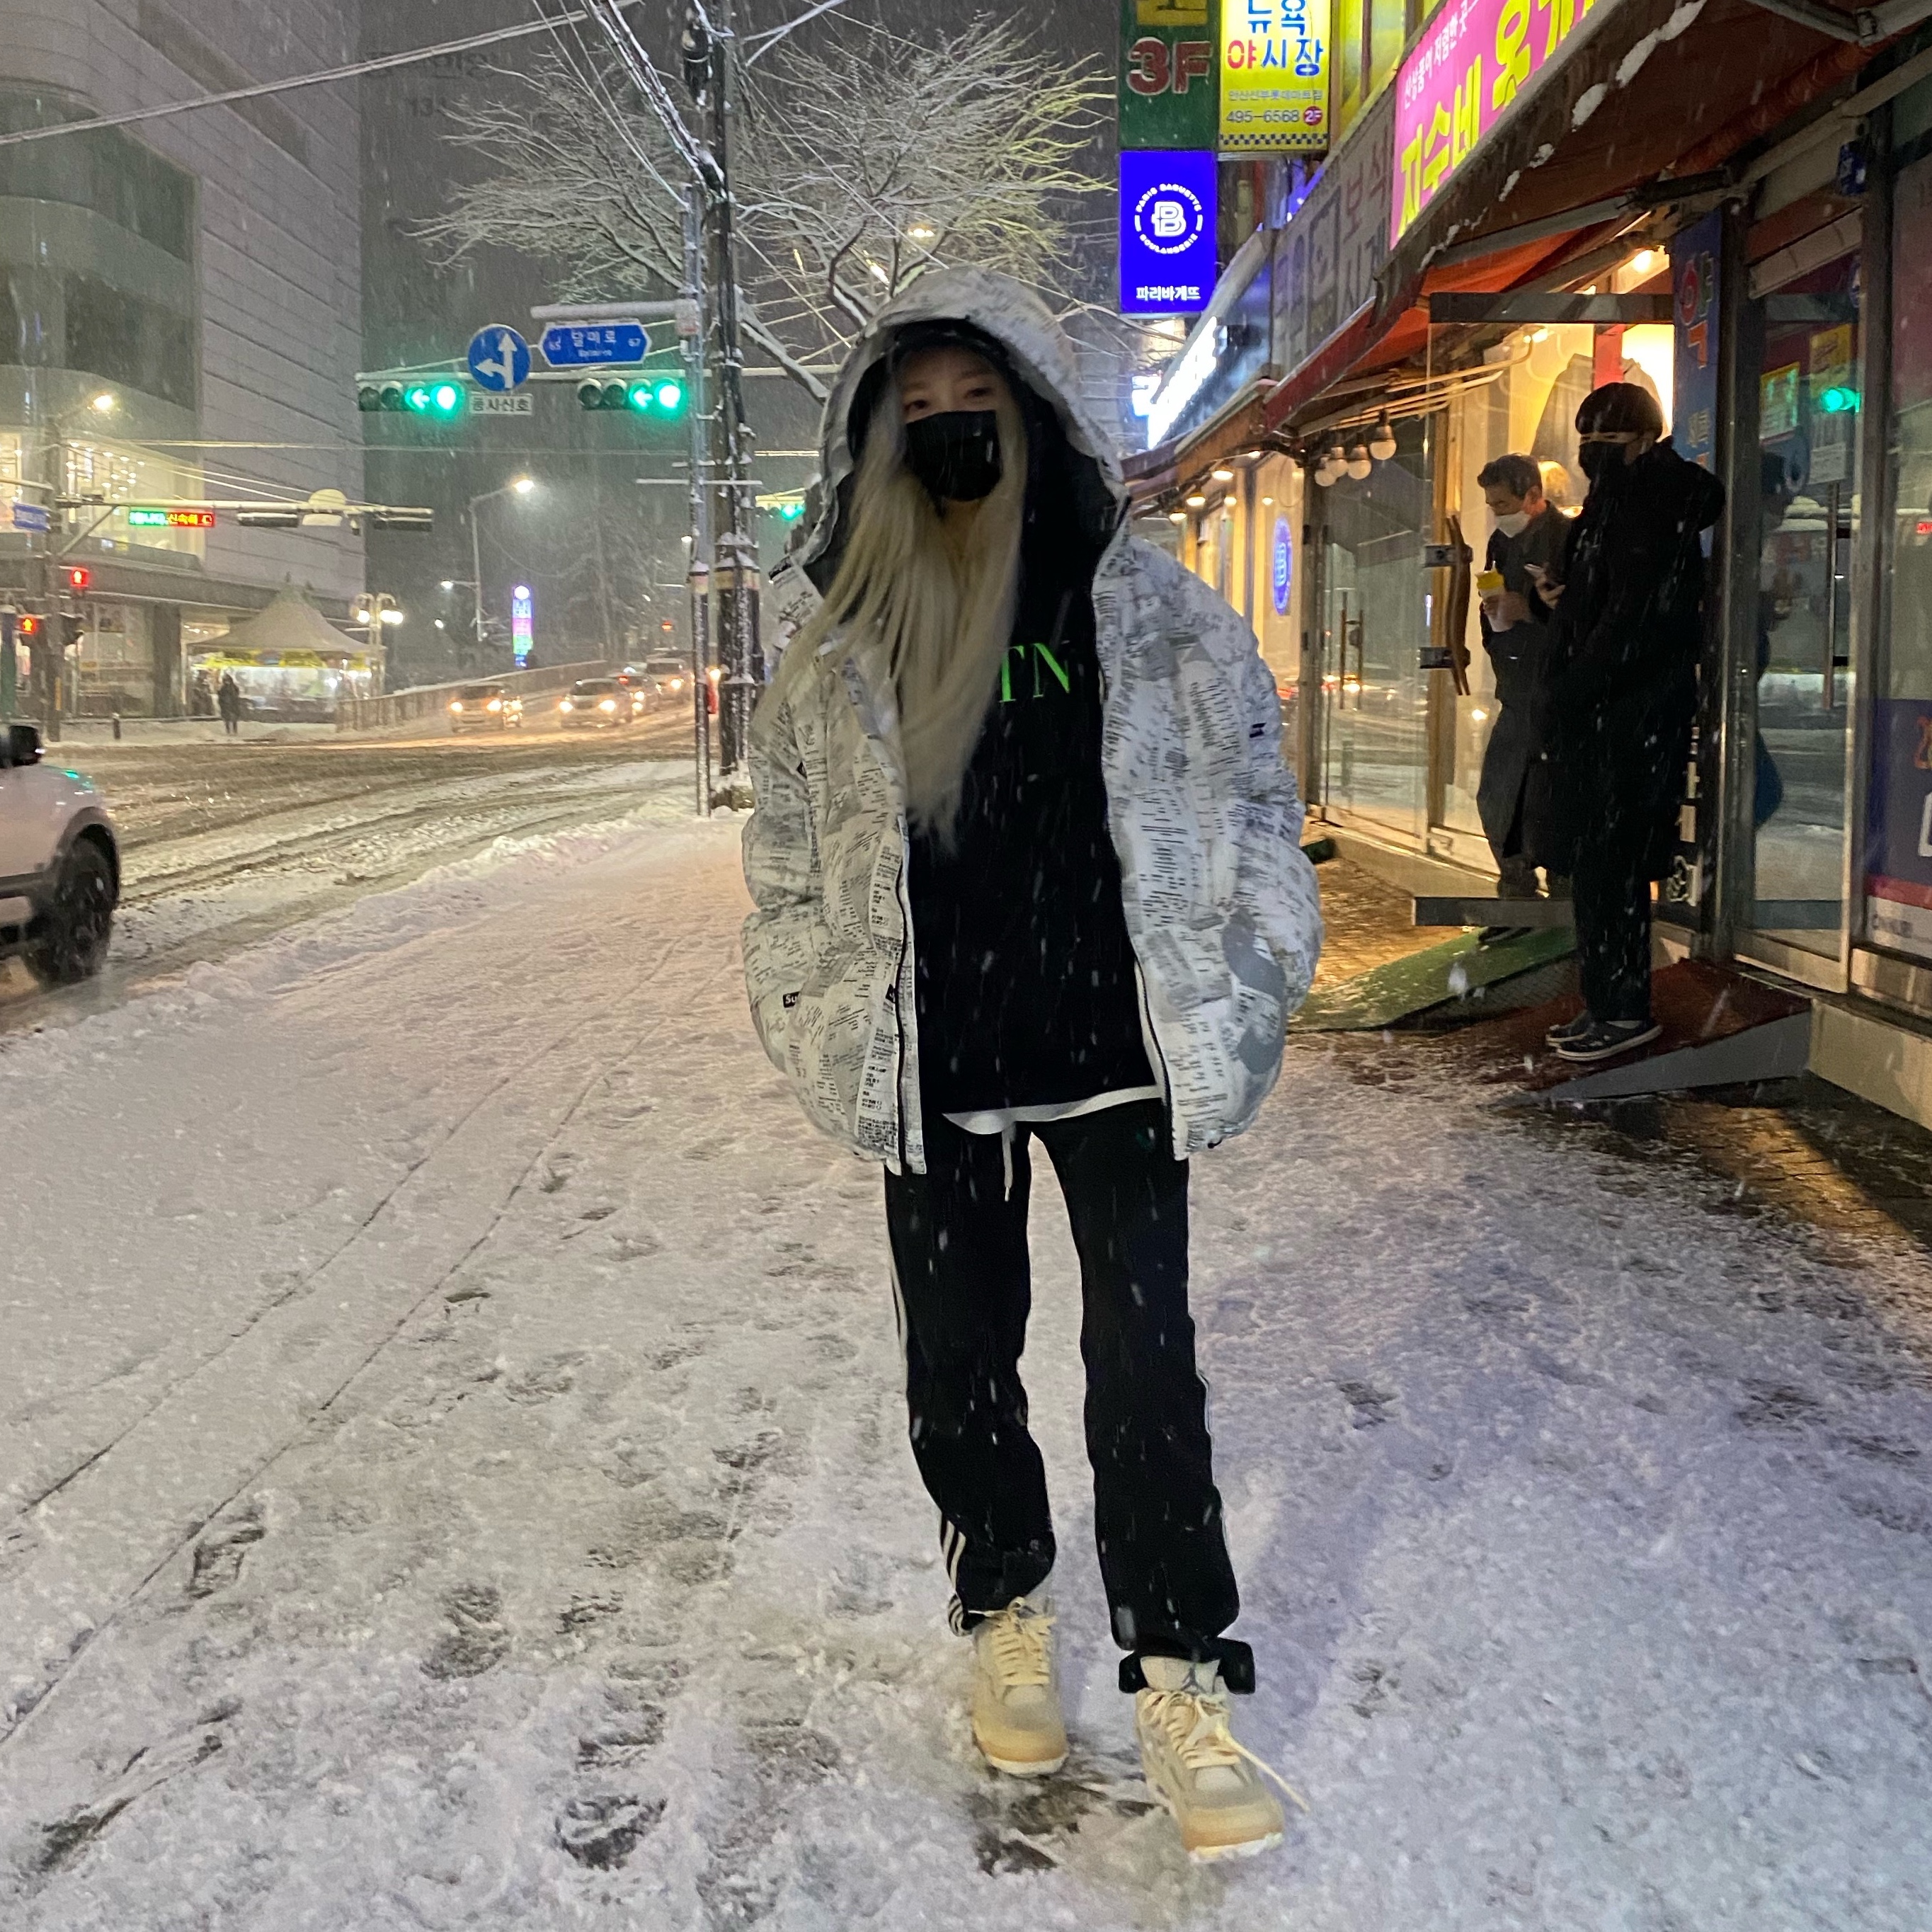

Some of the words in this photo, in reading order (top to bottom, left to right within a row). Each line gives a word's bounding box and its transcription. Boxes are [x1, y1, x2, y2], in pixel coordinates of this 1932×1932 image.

[1247, 0, 1306, 35] 뉴욕
[1127, 37, 1213, 96] 3F
[1227, 38, 1324, 77] 야시장
[1226, 109, 1300, 123] 495-6568
[1136, 285, 1201, 302] 파리바게뜨
